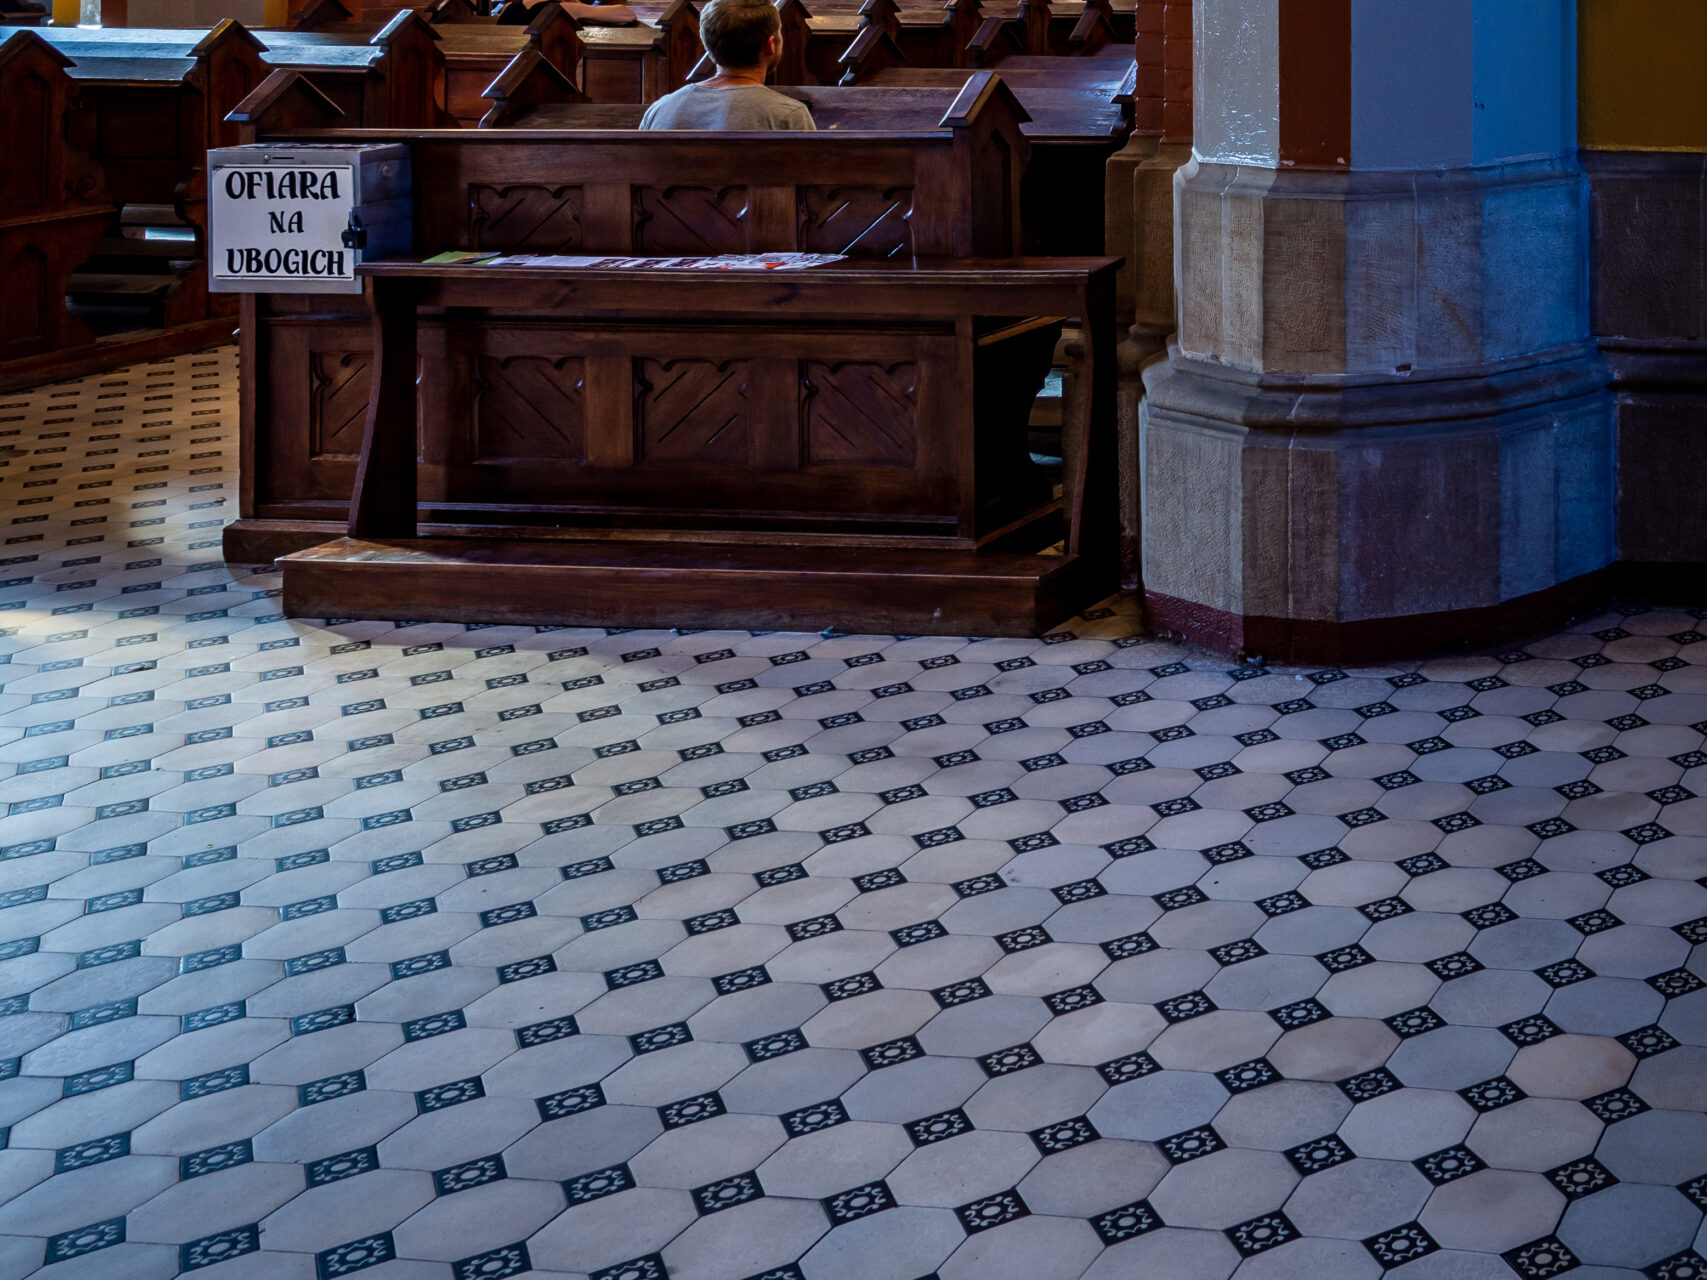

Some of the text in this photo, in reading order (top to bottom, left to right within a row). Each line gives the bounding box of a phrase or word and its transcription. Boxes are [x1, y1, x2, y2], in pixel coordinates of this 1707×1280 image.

[225, 170, 341, 200] OFIARA
[268, 210, 305, 234] NA
[226, 248, 346, 276] UBOGICH
